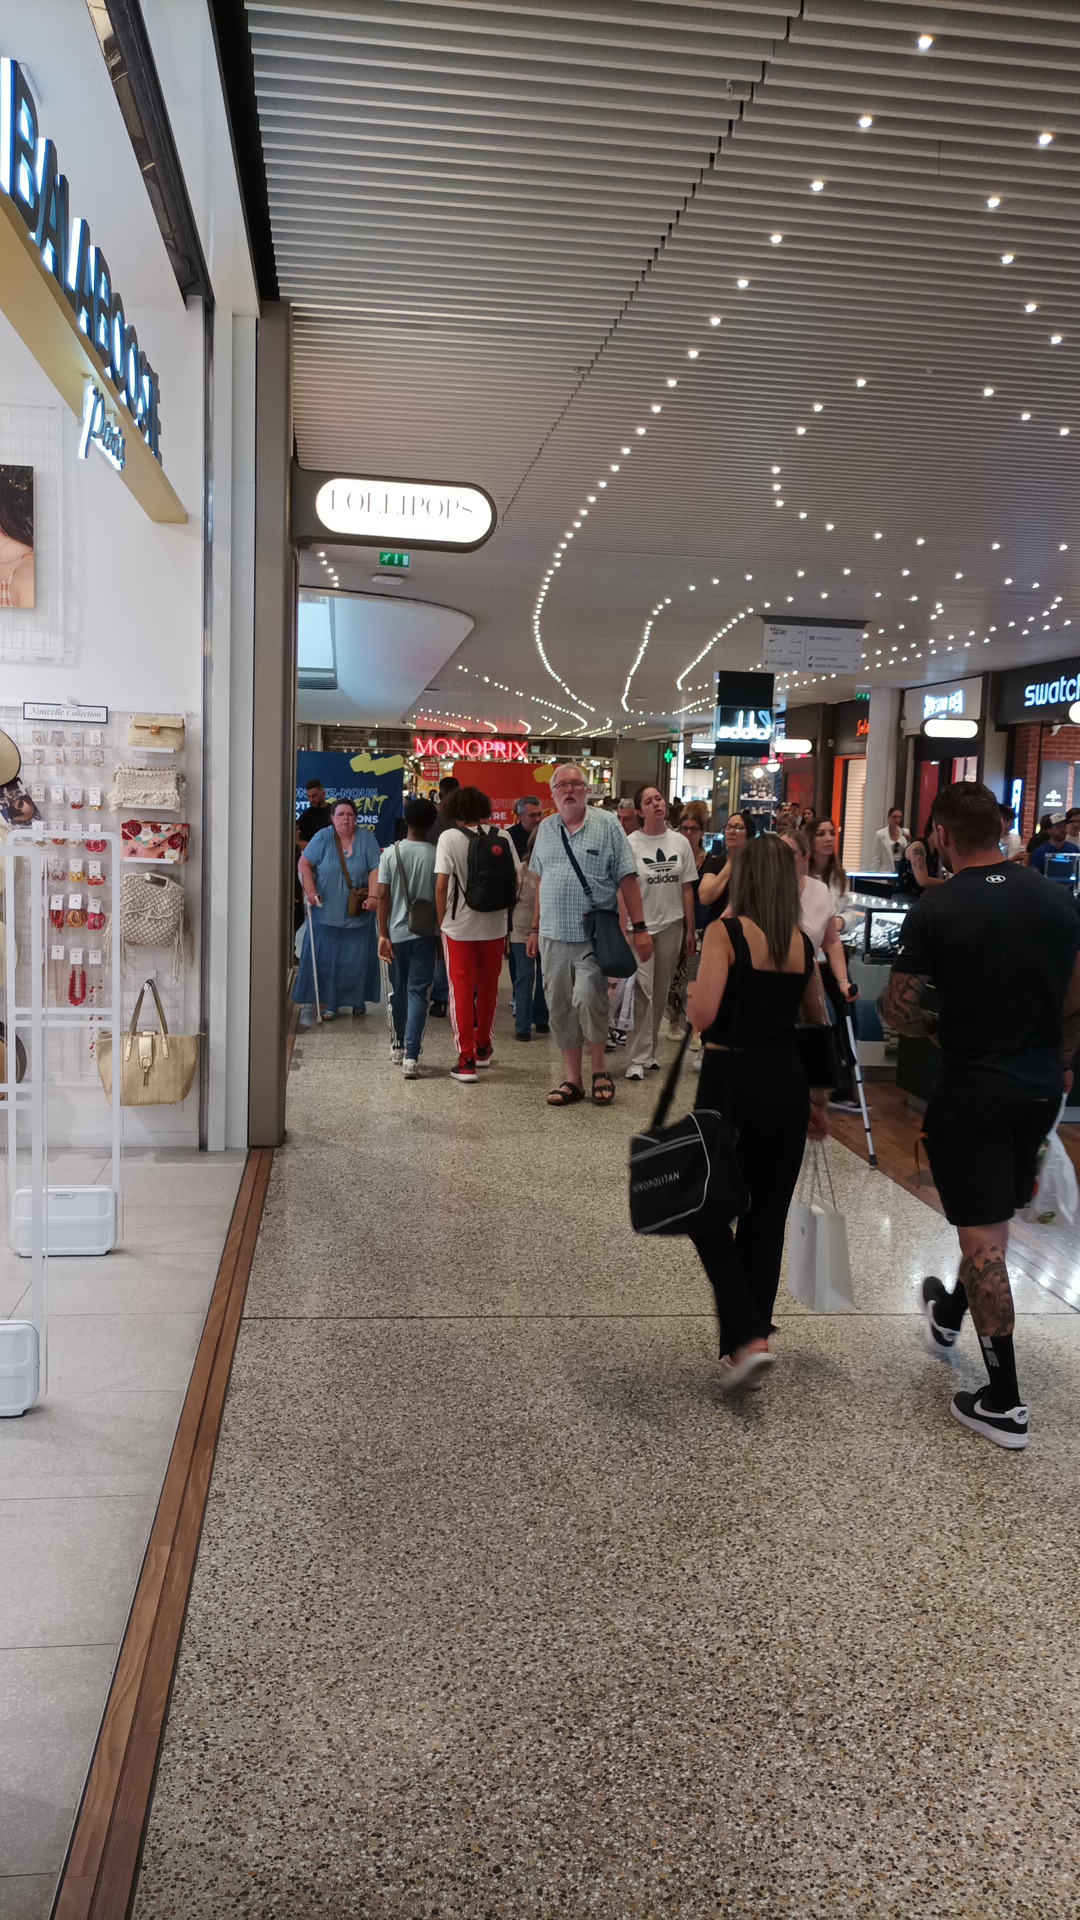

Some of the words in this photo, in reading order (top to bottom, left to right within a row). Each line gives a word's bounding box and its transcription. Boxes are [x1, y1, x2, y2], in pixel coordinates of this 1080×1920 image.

[331, 489, 473, 518] LOLLIPOPS
[29, 707, 65, 716] Nouvelle
[66, 709, 102, 718] Collection
[415, 737, 527, 760] MONOPRIX
[647, 873, 680, 885] adidas
